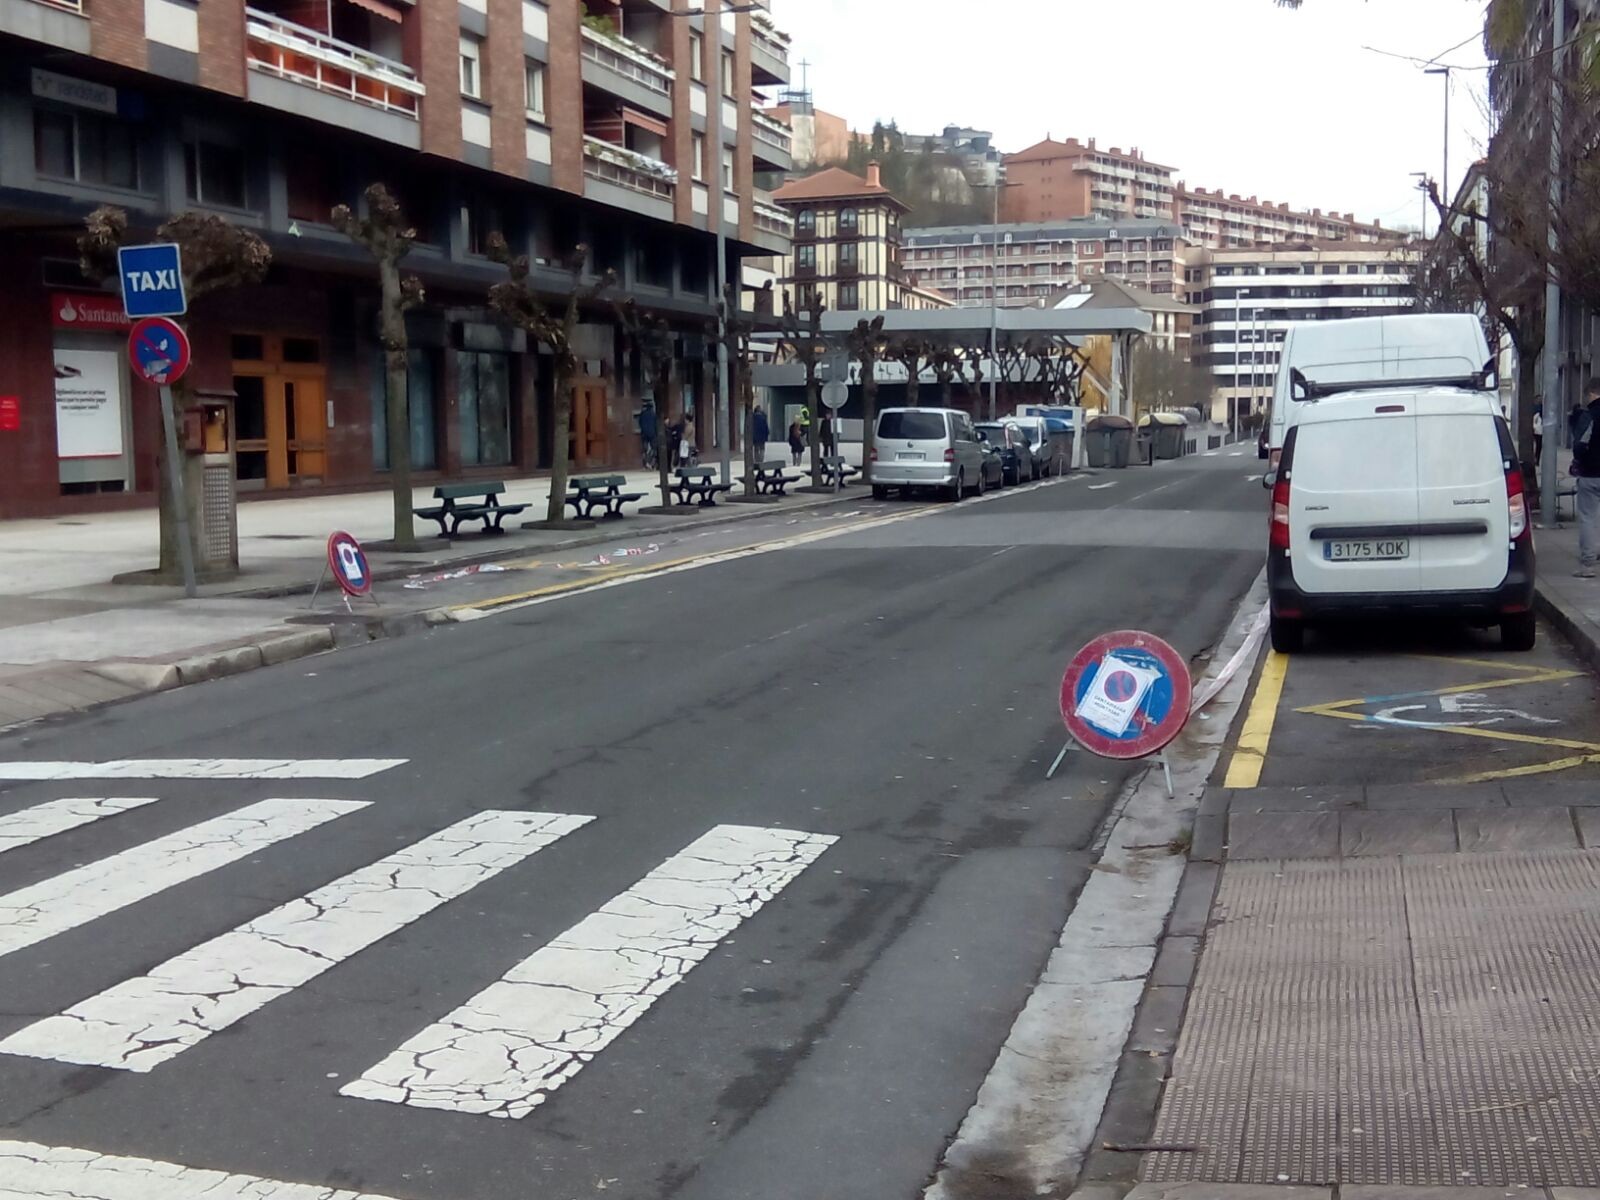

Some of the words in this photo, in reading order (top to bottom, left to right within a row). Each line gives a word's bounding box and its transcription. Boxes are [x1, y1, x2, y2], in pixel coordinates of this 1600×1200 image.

[126, 269, 177, 292] TAXI
[78, 303, 131, 324] Santand
[1334, 543, 1371, 557] 3175
[1376, 541, 1404, 556] KDK
